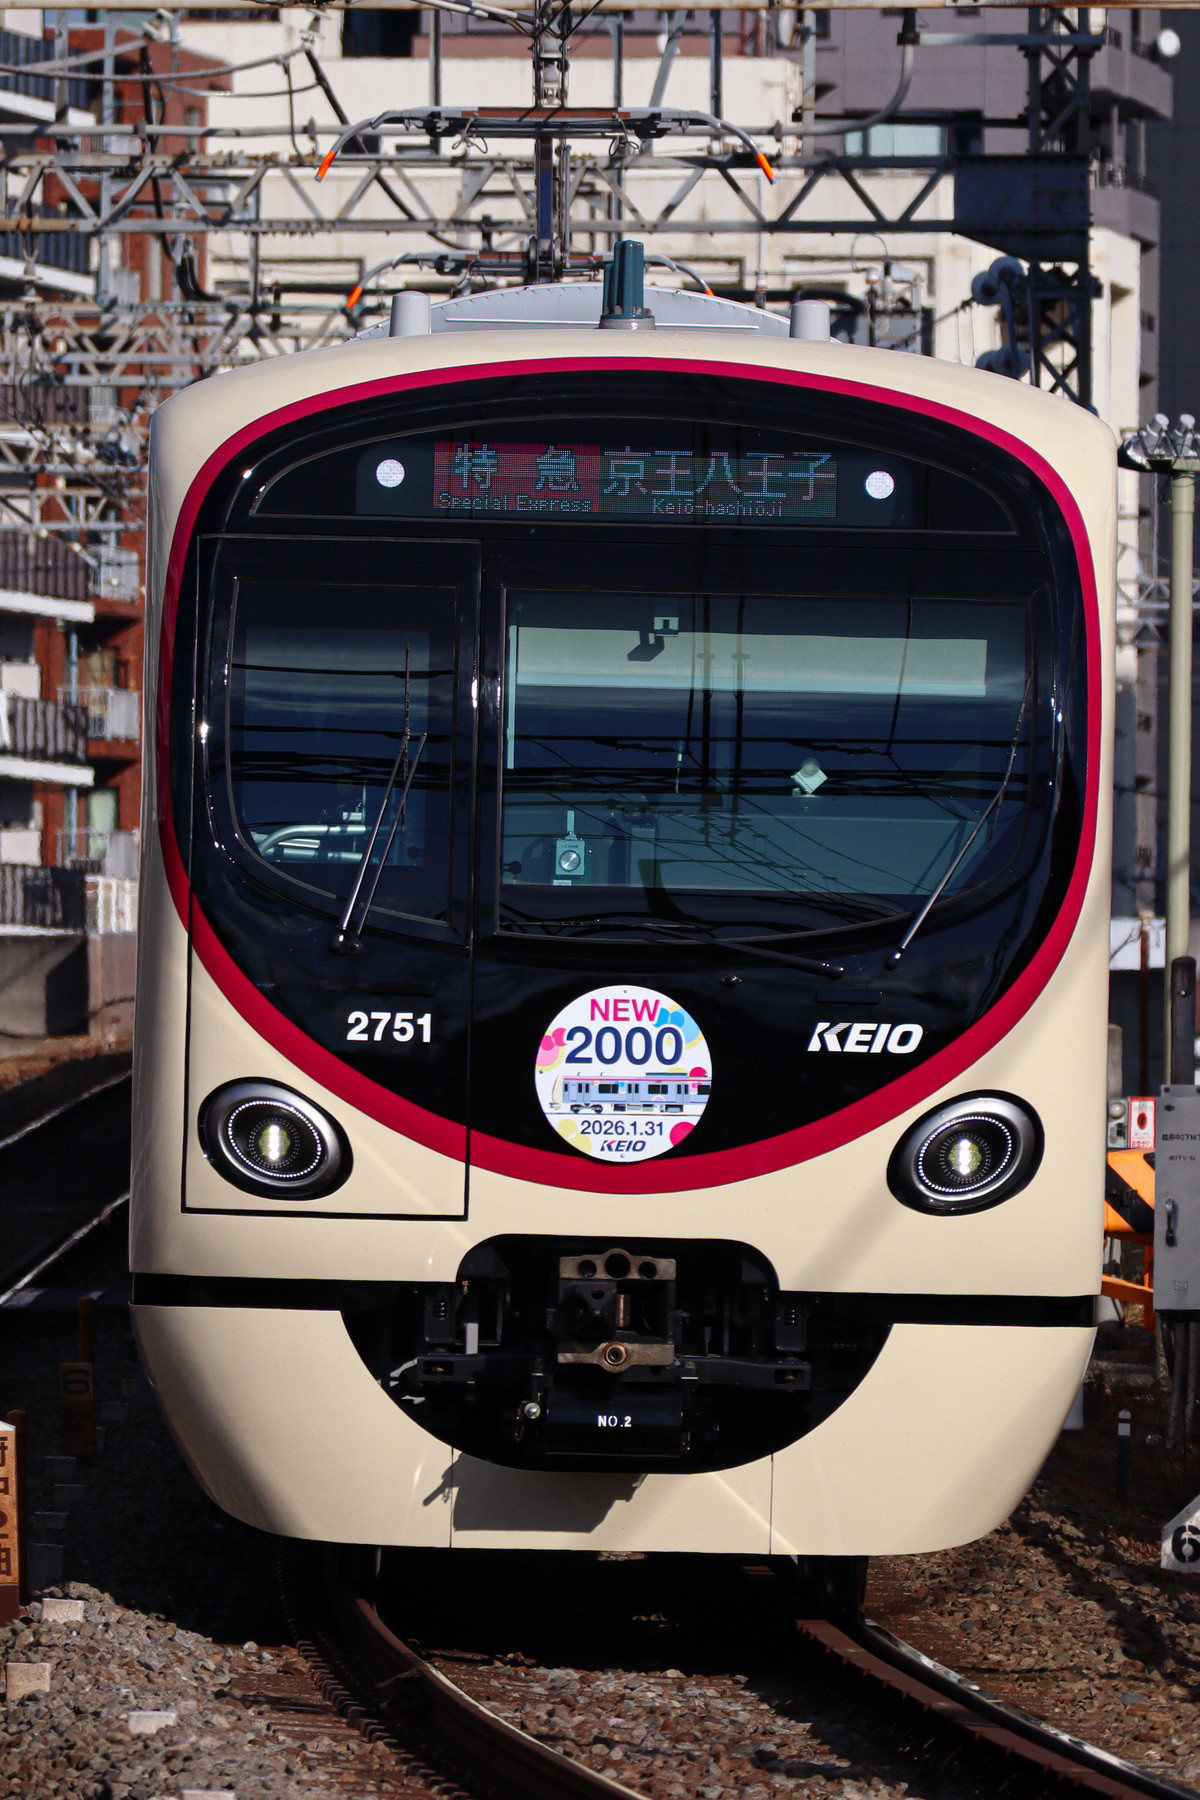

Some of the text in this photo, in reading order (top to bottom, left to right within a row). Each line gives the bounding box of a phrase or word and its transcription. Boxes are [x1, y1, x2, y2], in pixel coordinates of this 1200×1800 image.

[454, 443, 578, 491] 特急
[603, 445, 836, 500] 京王八王子
[439, 493, 592, 513] Special Express
[590, 998, 661, 1022] NEW
[346, 1010, 432, 1043] 2751
[807, 1022, 924, 1054] KEIO
[565, 1025, 684, 1066] 2000
[580, 1120, 663, 1136] 2026.1.31
[600, 1140, 647, 1152] KEIO
[597, 1415, 633, 1428] NO.2
[1171, 1525, 1200, 1564] 6
